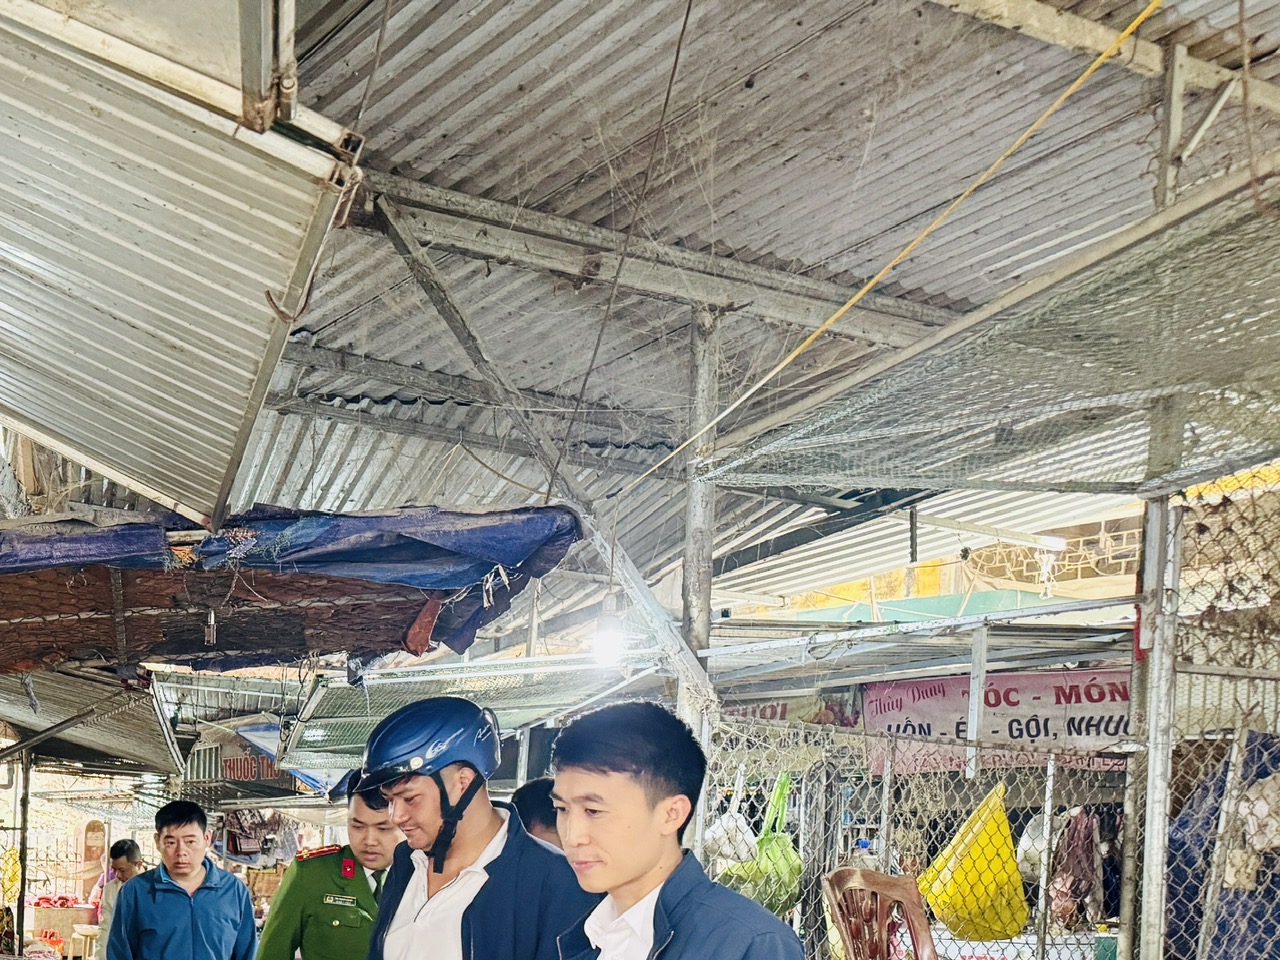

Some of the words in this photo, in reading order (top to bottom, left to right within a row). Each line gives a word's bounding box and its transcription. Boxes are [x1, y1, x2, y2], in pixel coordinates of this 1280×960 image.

[868, 694, 903, 717] Thùy
[906, 682, 948, 704] Dung
[222, 747, 258, 781] THUỐC
